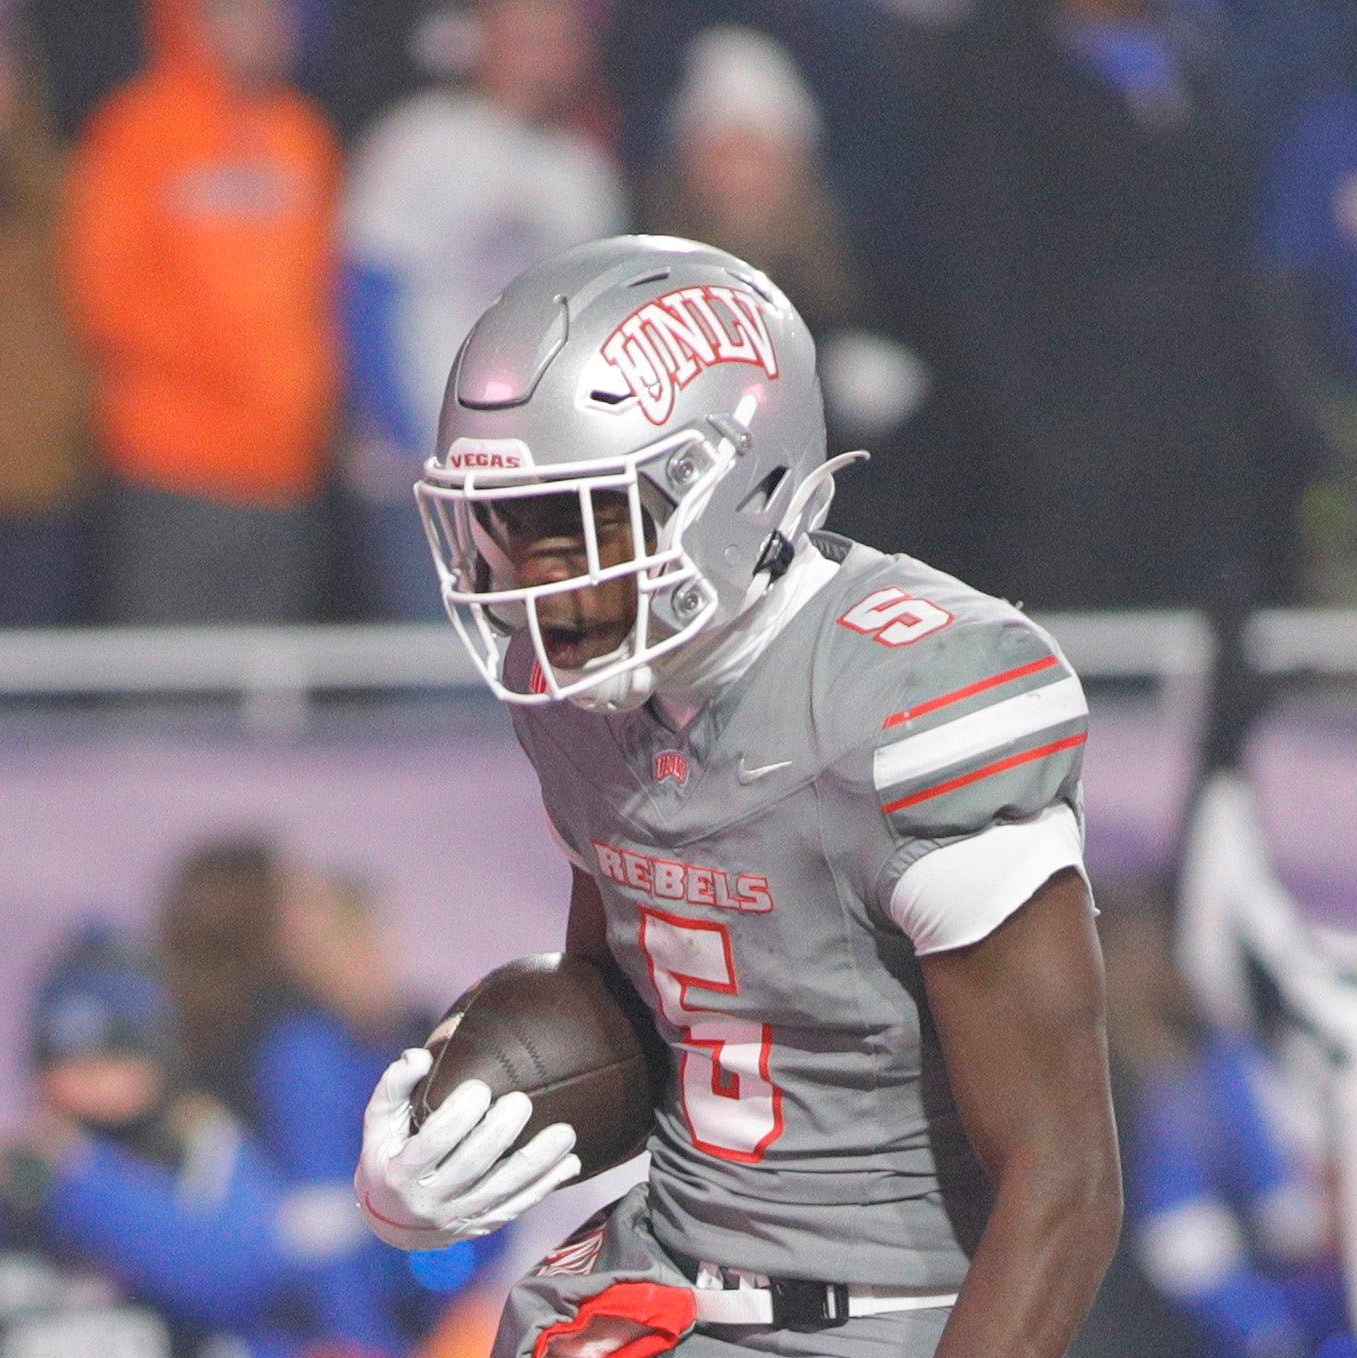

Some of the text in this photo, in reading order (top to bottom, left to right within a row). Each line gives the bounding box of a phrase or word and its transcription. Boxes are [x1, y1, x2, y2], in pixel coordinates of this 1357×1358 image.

[601, 285, 780, 426] UNLV
[450, 453, 521, 469] VEGAS
[835, 586, 955, 648] 5
[590, 840, 774, 913] REBELS
[637, 902, 785, 1163] 5
